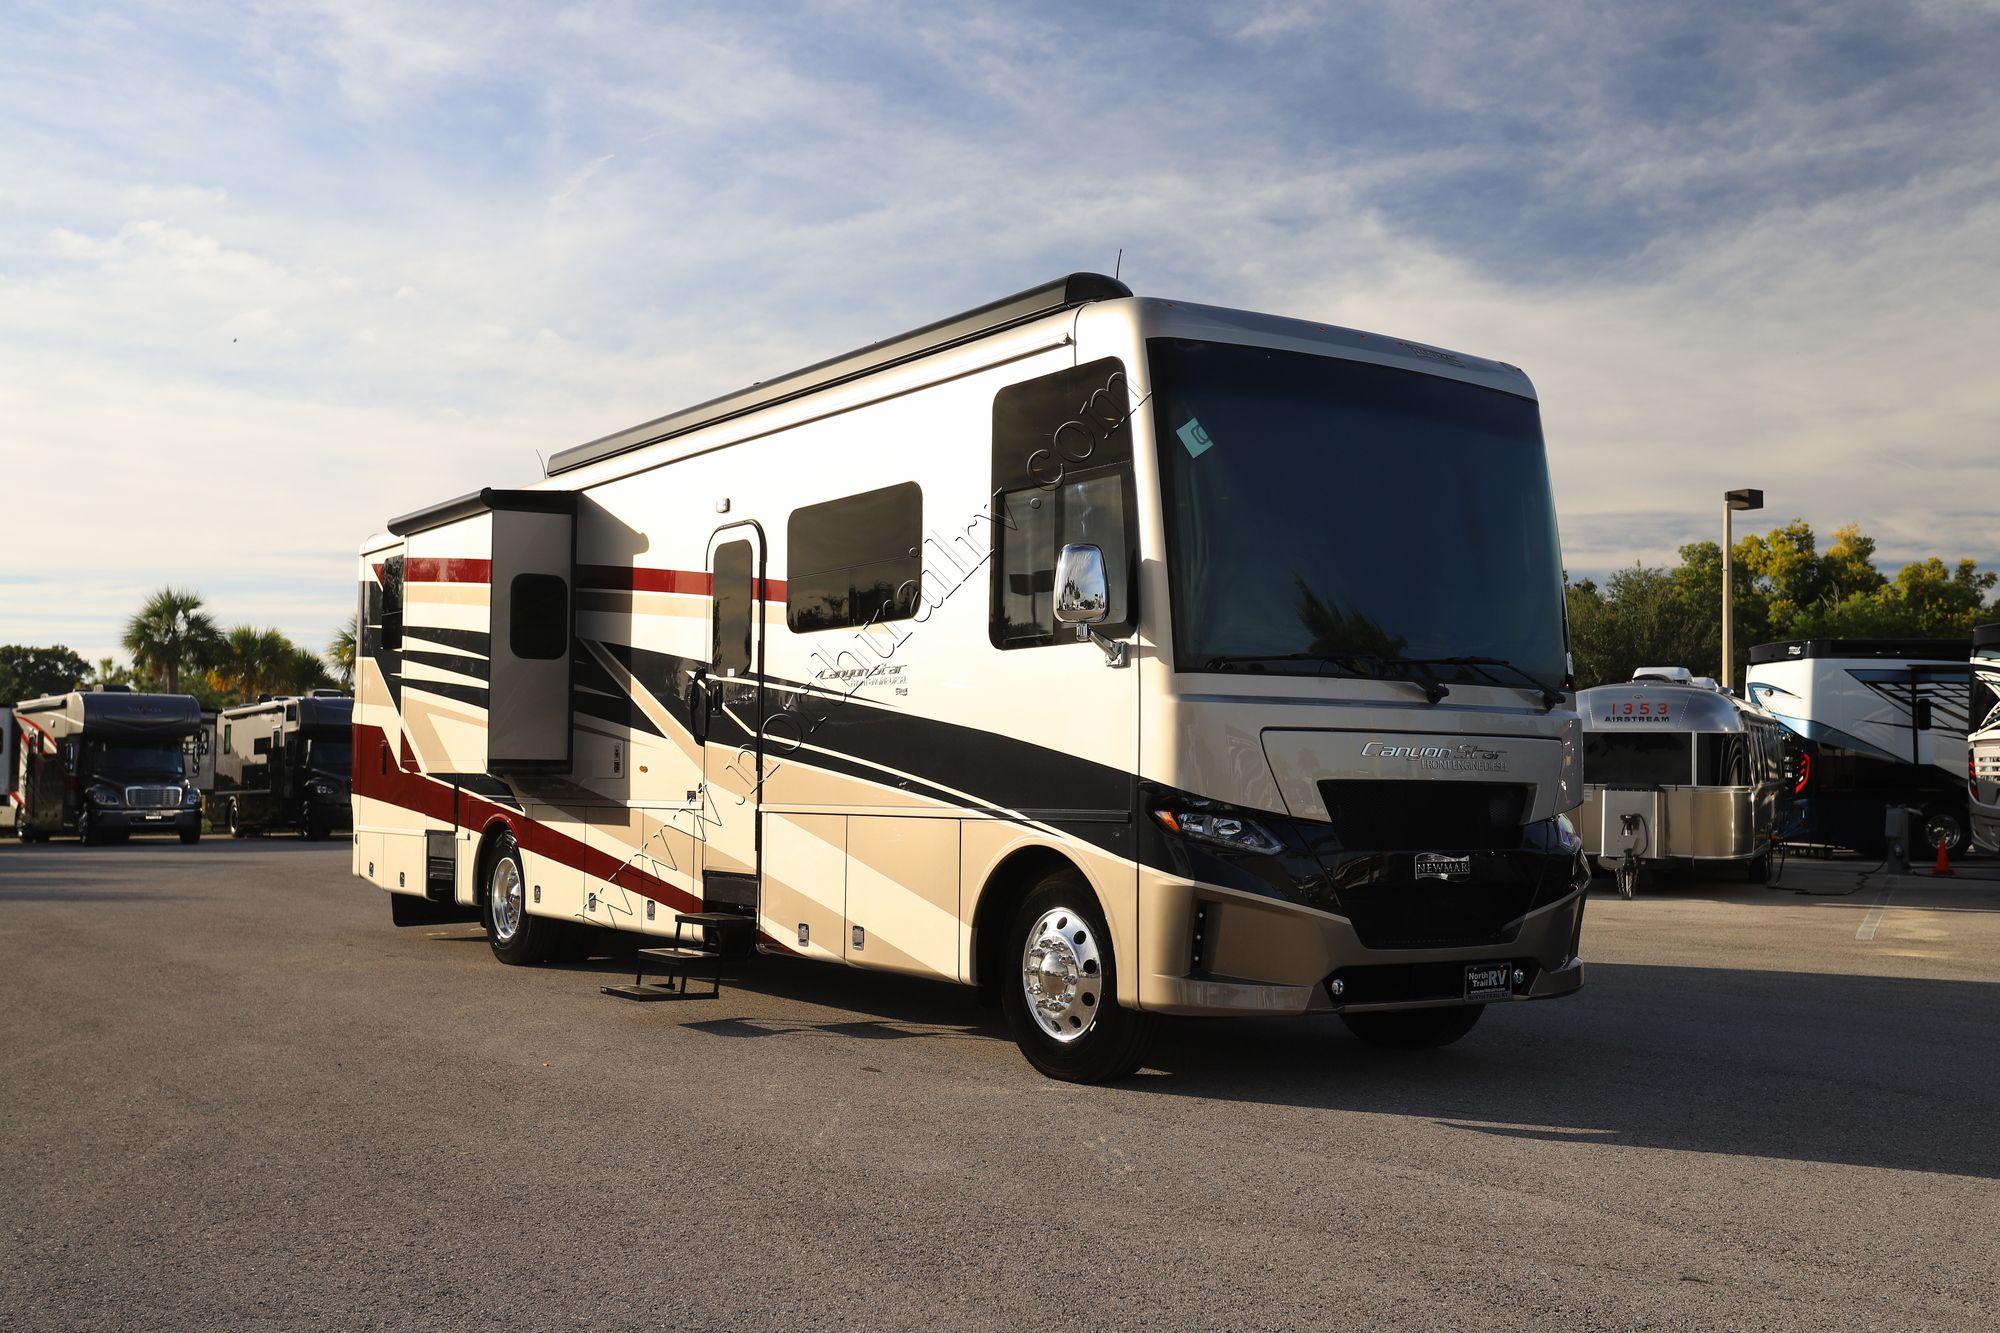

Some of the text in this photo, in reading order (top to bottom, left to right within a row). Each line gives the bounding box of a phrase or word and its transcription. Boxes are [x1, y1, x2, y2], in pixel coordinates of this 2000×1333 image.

[1611, 703, 1669, 715] 1353
[1361, 741, 1508, 762] Canyon Star
[1420, 759, 1508, 772] FRONT ENGINE DIESEL
[1417, 863, 1468, 872] NEWMAR
[1469, 970, 1507, 986] North RV
[1472, 979, 1488, 987] Trail
